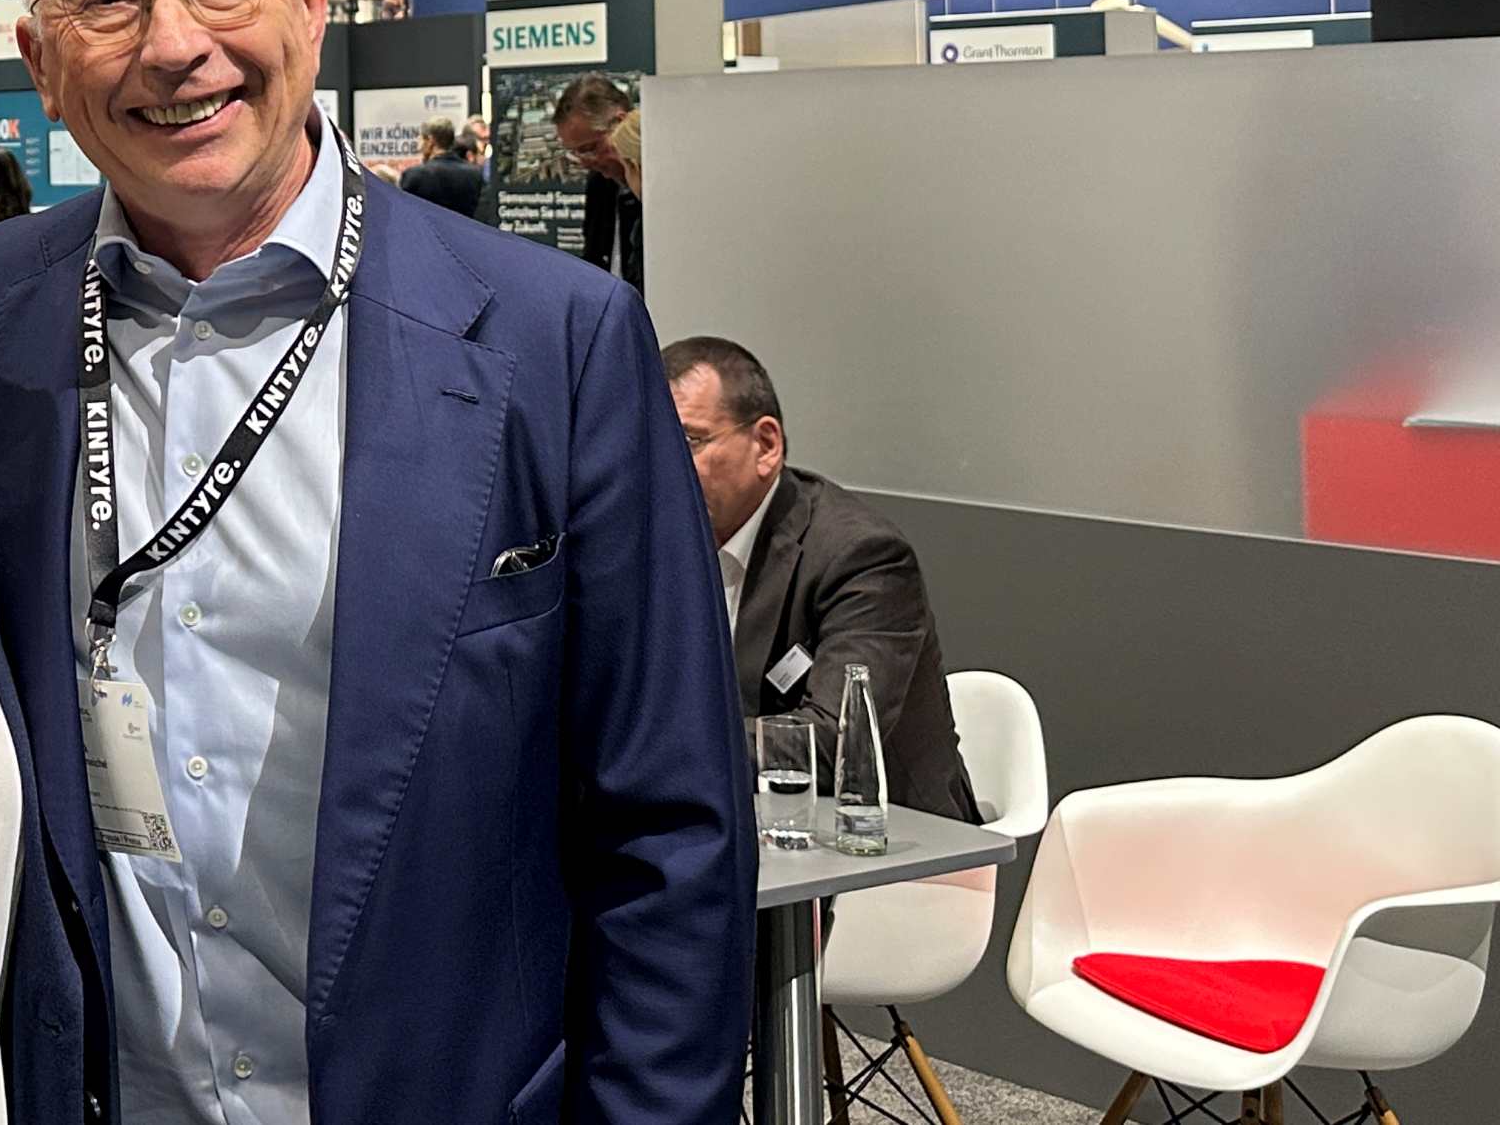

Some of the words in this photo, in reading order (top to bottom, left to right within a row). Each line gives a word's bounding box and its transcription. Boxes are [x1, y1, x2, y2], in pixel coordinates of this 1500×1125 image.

[492, 20, 597, 52] SIEMENS
[963, 44, 993, 59] Grant
[994, 43, 1044, 57] Thornton
[361, 126, 383, 139] WIR
